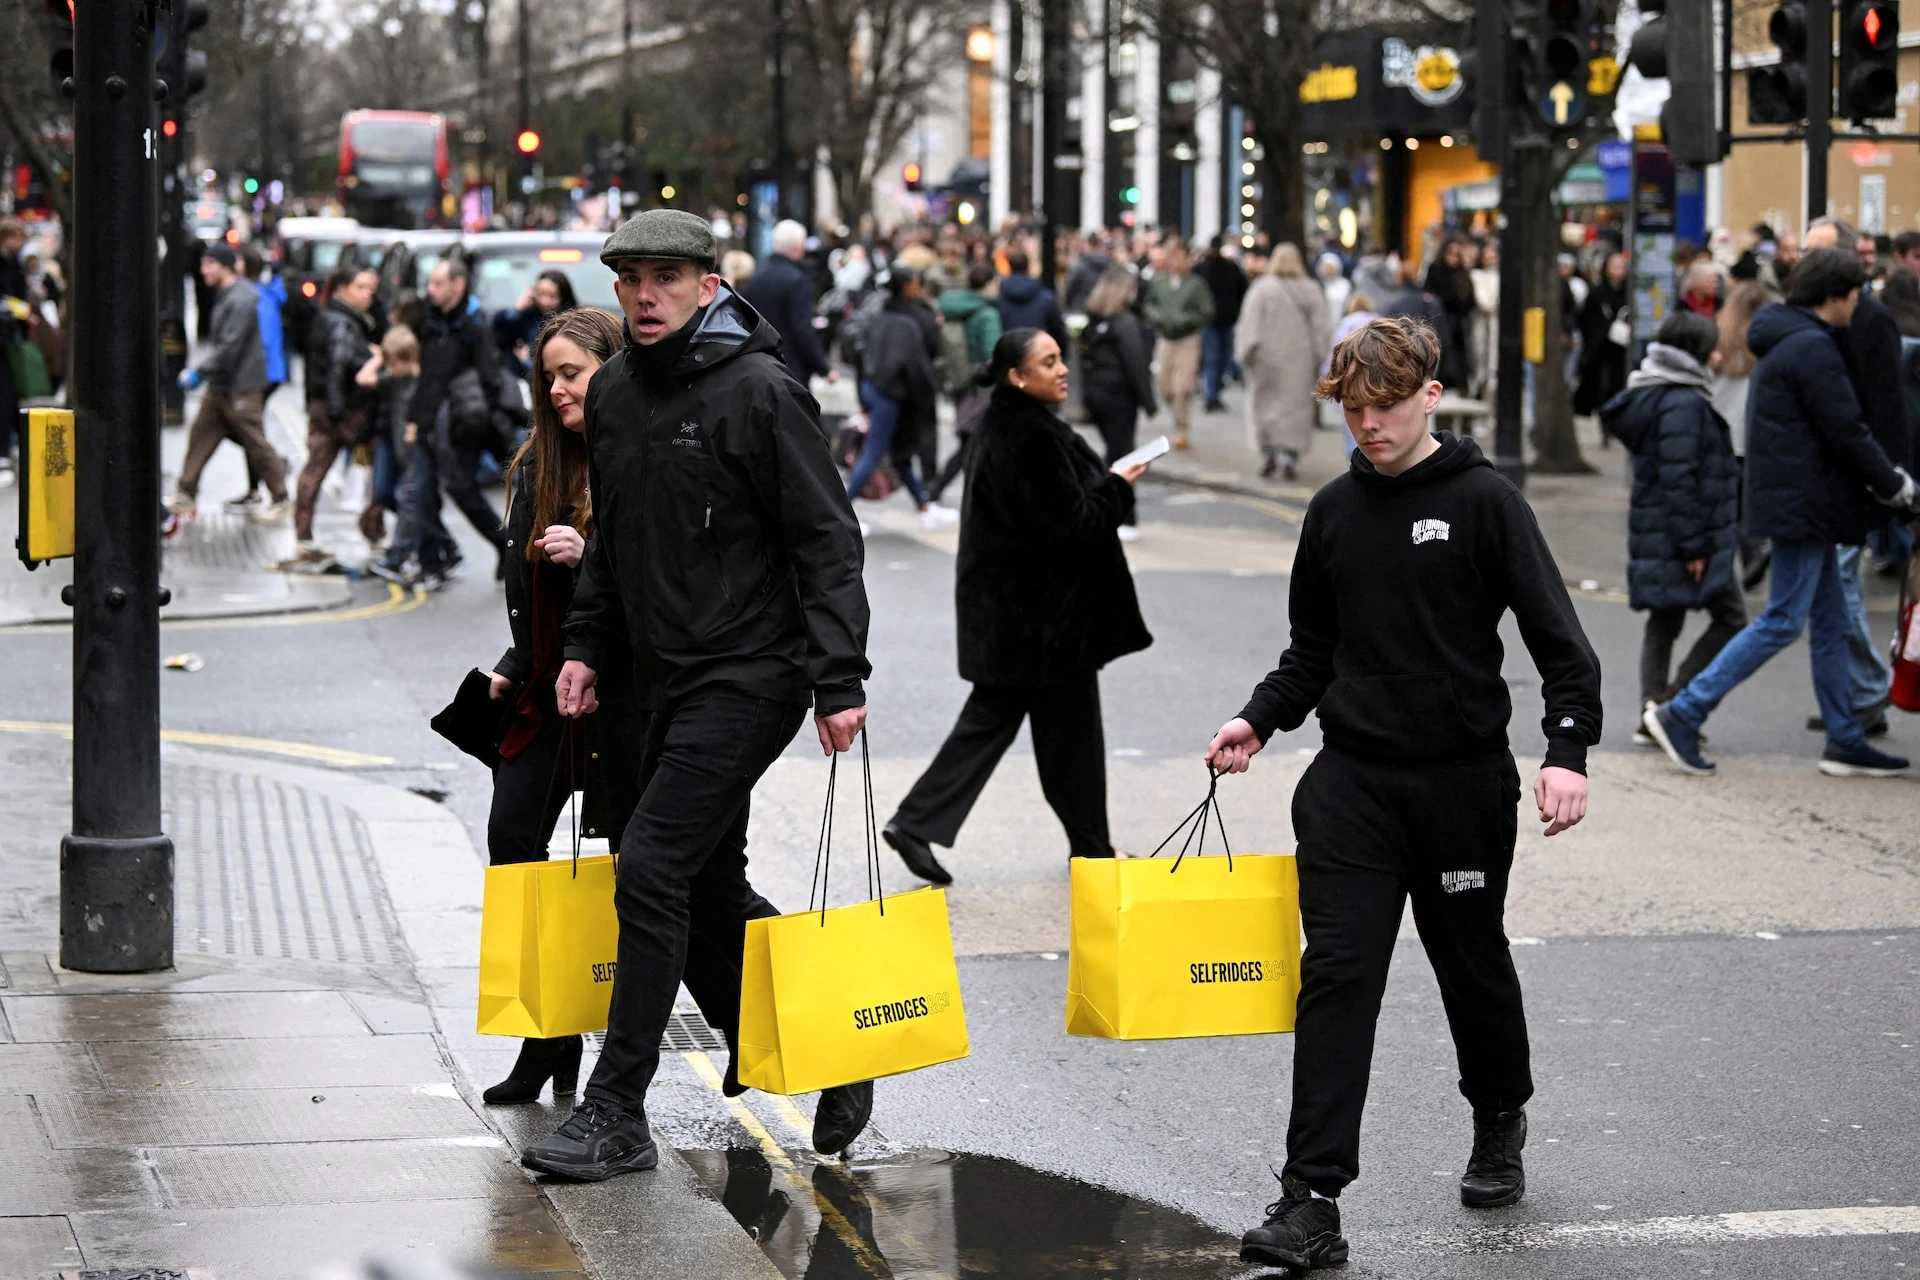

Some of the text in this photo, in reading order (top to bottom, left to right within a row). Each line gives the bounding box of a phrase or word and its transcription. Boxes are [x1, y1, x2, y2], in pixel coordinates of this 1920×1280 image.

[143, 128, 157, 160] 1
[1412, 518, 1451, 537] BILLIONAIRE
[1441, 870, 1485, 885] BILLIONAIRE
[1455, 879, 1485, 892] BOYS CLUB
